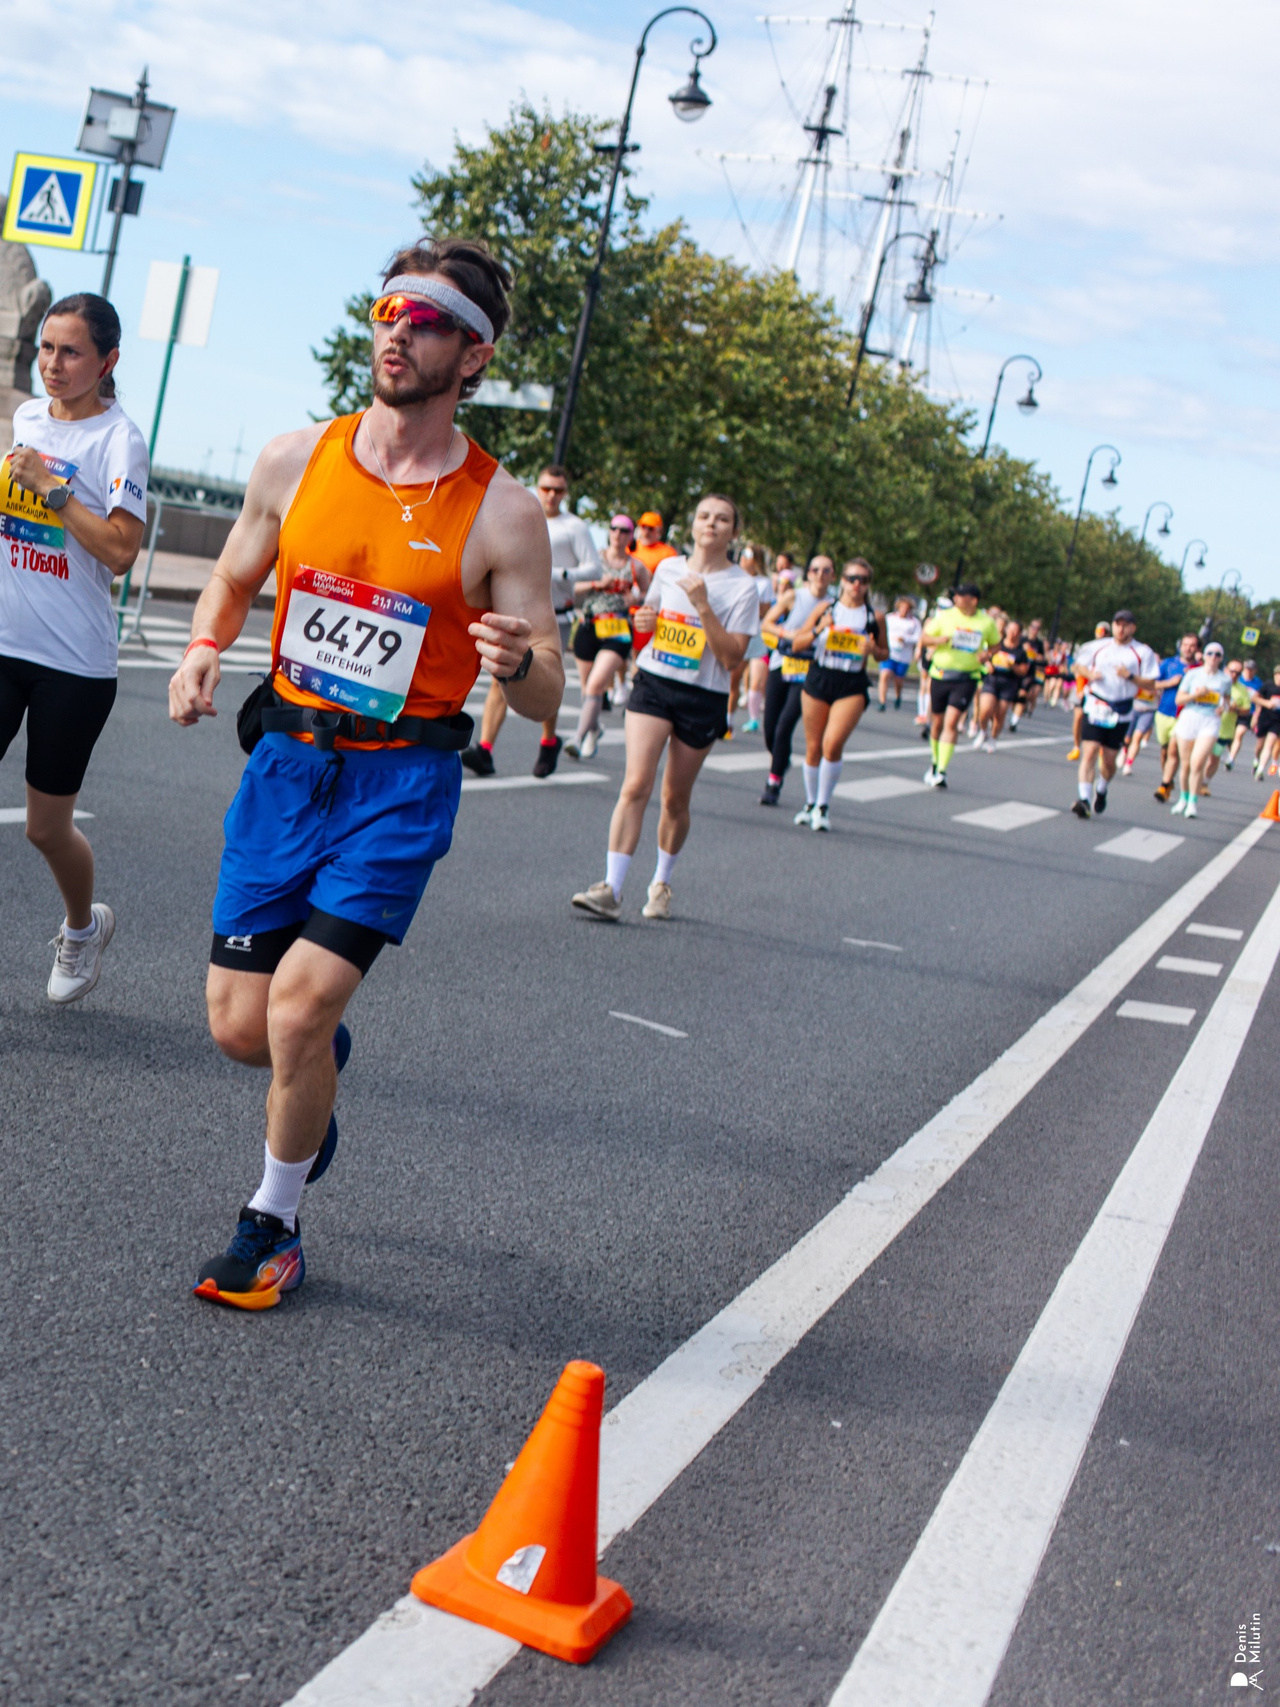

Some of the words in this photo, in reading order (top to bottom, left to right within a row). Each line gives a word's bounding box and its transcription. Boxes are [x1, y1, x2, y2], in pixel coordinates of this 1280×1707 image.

[124, 479, 143, 501] ПСБ
[5, 501, 49, 520] АЛЕКСАНДРА
[10, 544, 19, 568] С
[22, 545, 69, 580] ТОБОЙ
[312, 580, 354, 598] МАРАФОН
[313, 572, 337, 585] ПОЛУ
[372, 593, 392, 611] 21,1
[393, 600, 414, 616] КМ
[303, 607, 402, 667] 6479
[658, 624, 697, 647] 3006
[316, 650, 373, 678] ЕВГЕНИЙ
